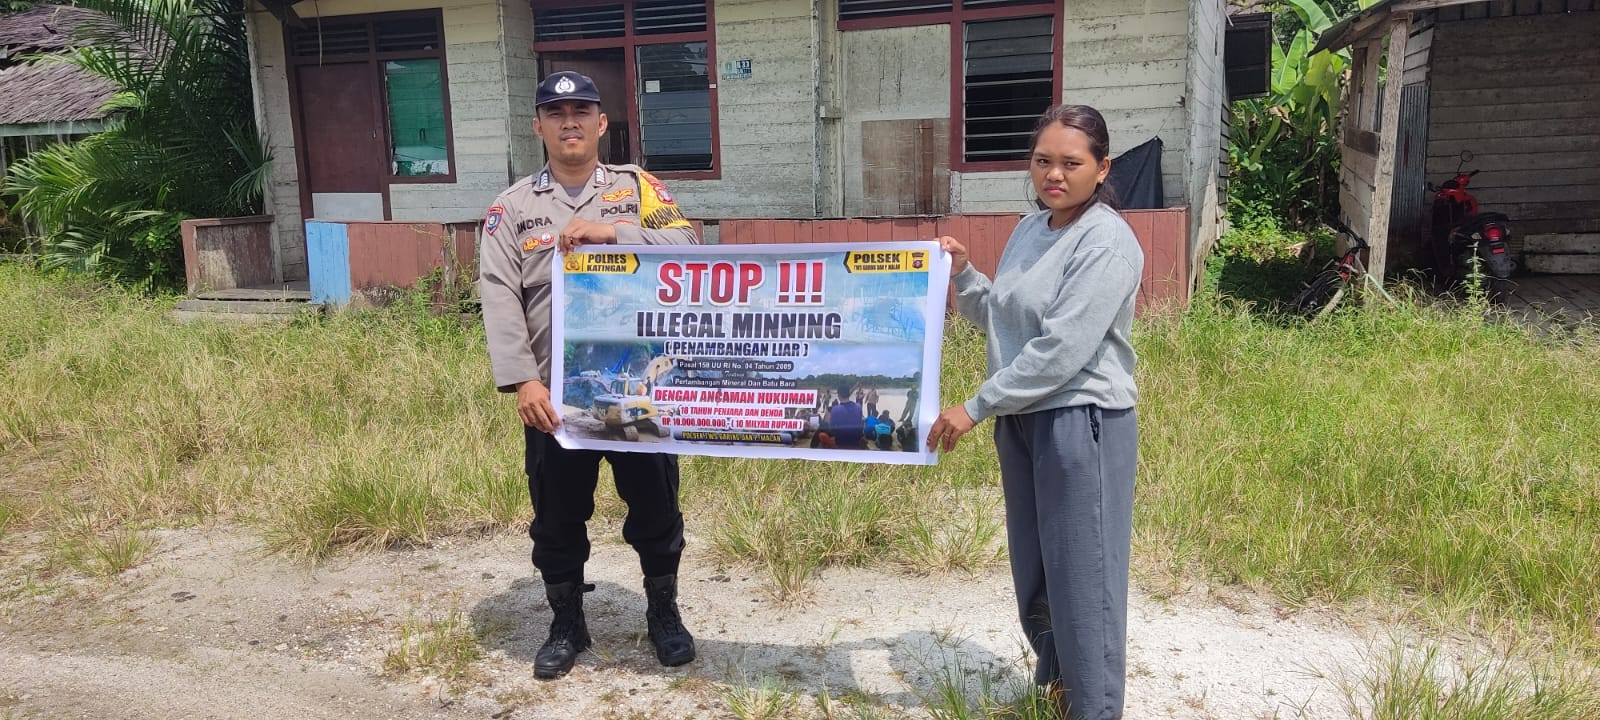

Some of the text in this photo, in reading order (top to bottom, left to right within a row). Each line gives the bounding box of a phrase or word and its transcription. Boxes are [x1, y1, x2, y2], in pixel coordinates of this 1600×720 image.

[600, 203, 638, 217] POLRI
[587, 254, 627, 265] POLRES
[853, 254, 900, 263] POLSEK
[658, 262, 823, 303] STOP !!!
[637, 312, 841, 339] ILLEGAL MINNING
[673, 342, 768, 356] PENAMBANGAN
[771, 343, 800, 356] LIAR
[674, 379, 721, 387] Pertambangan
[654, 389, 815, 405] DENGAN ANCAMAN HUKUMAN
[690, 406, 713, 416] TAHUN
[713, 407, 743, 417] PENJARA
[744, 408, 759, 417] DAN
[760, 409, 783, 418] BENDA
[735, 419, 744, 428] 10
[770, 420, 798, 430] RUPIAH
